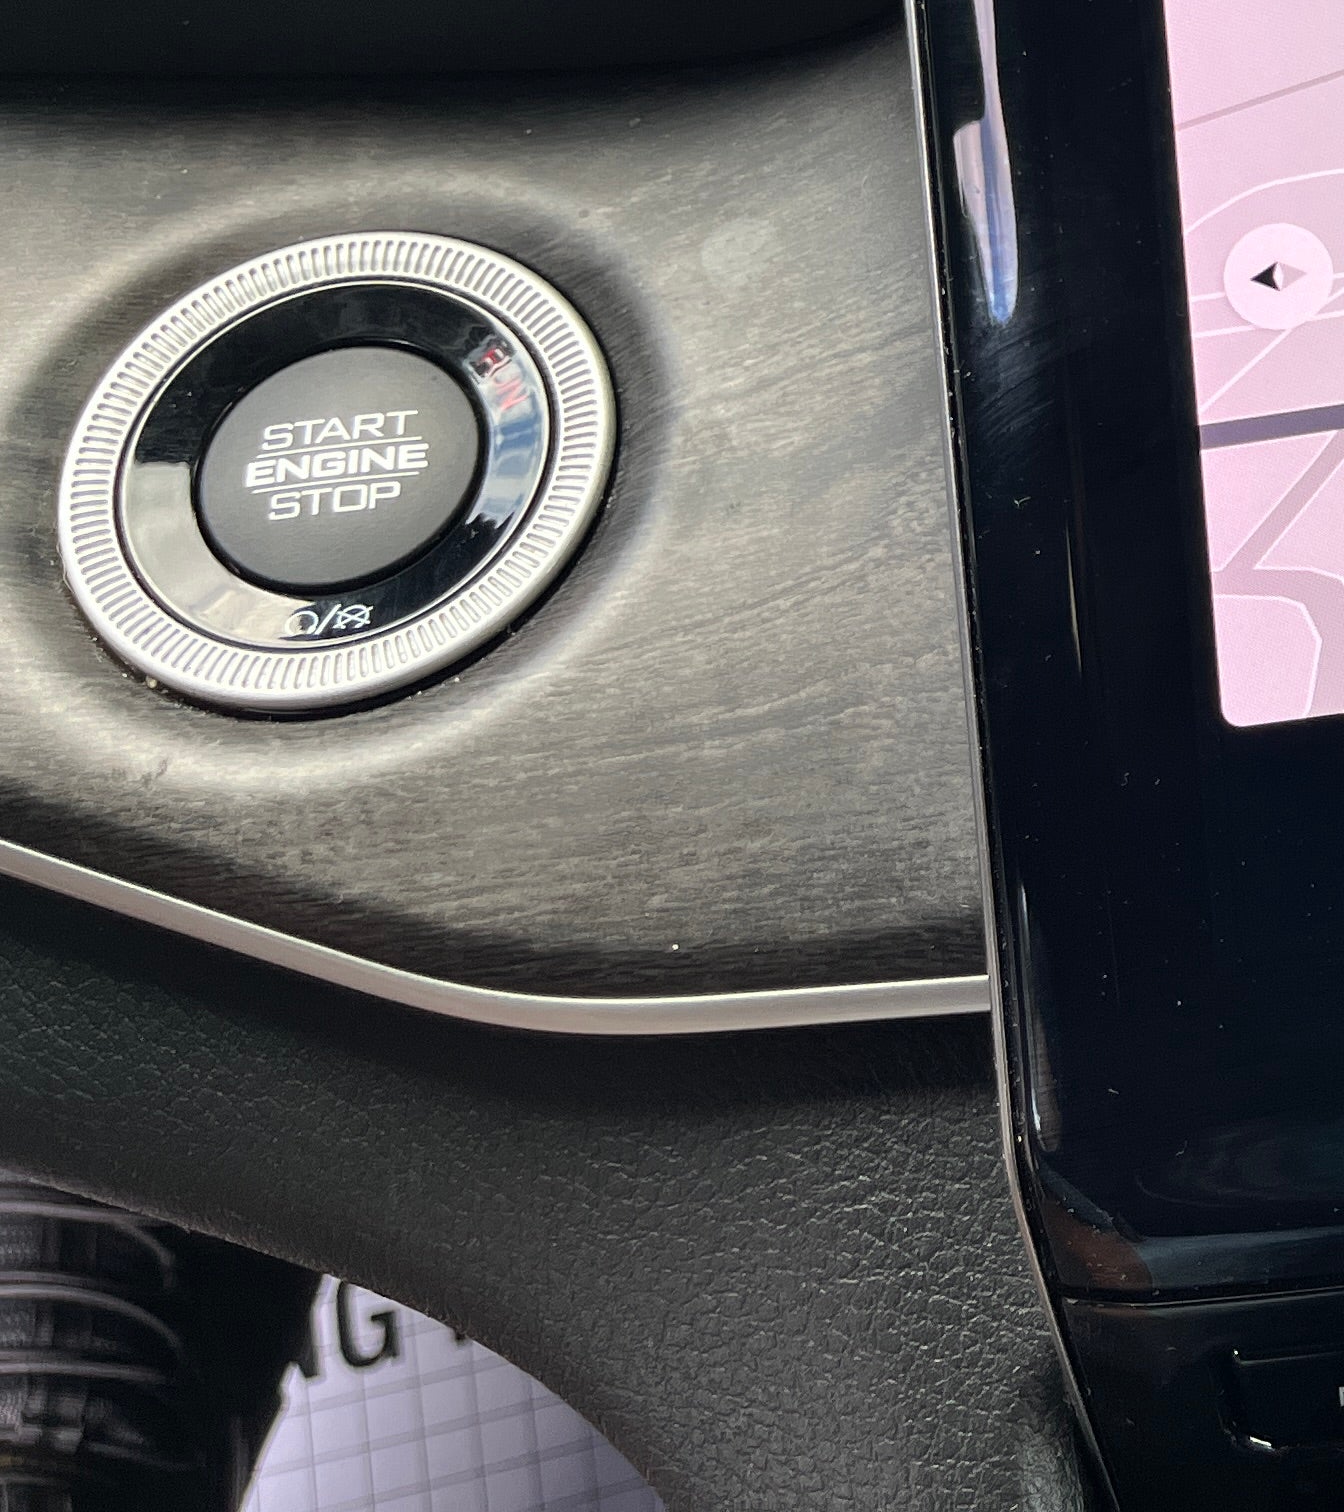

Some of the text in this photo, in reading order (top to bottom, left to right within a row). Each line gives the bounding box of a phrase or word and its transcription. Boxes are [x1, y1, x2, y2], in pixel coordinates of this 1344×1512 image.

[262, 410, 418, 449] START
[245, 442, 428, 487] ENGINE
[268, 480, 401, 521] STOP
